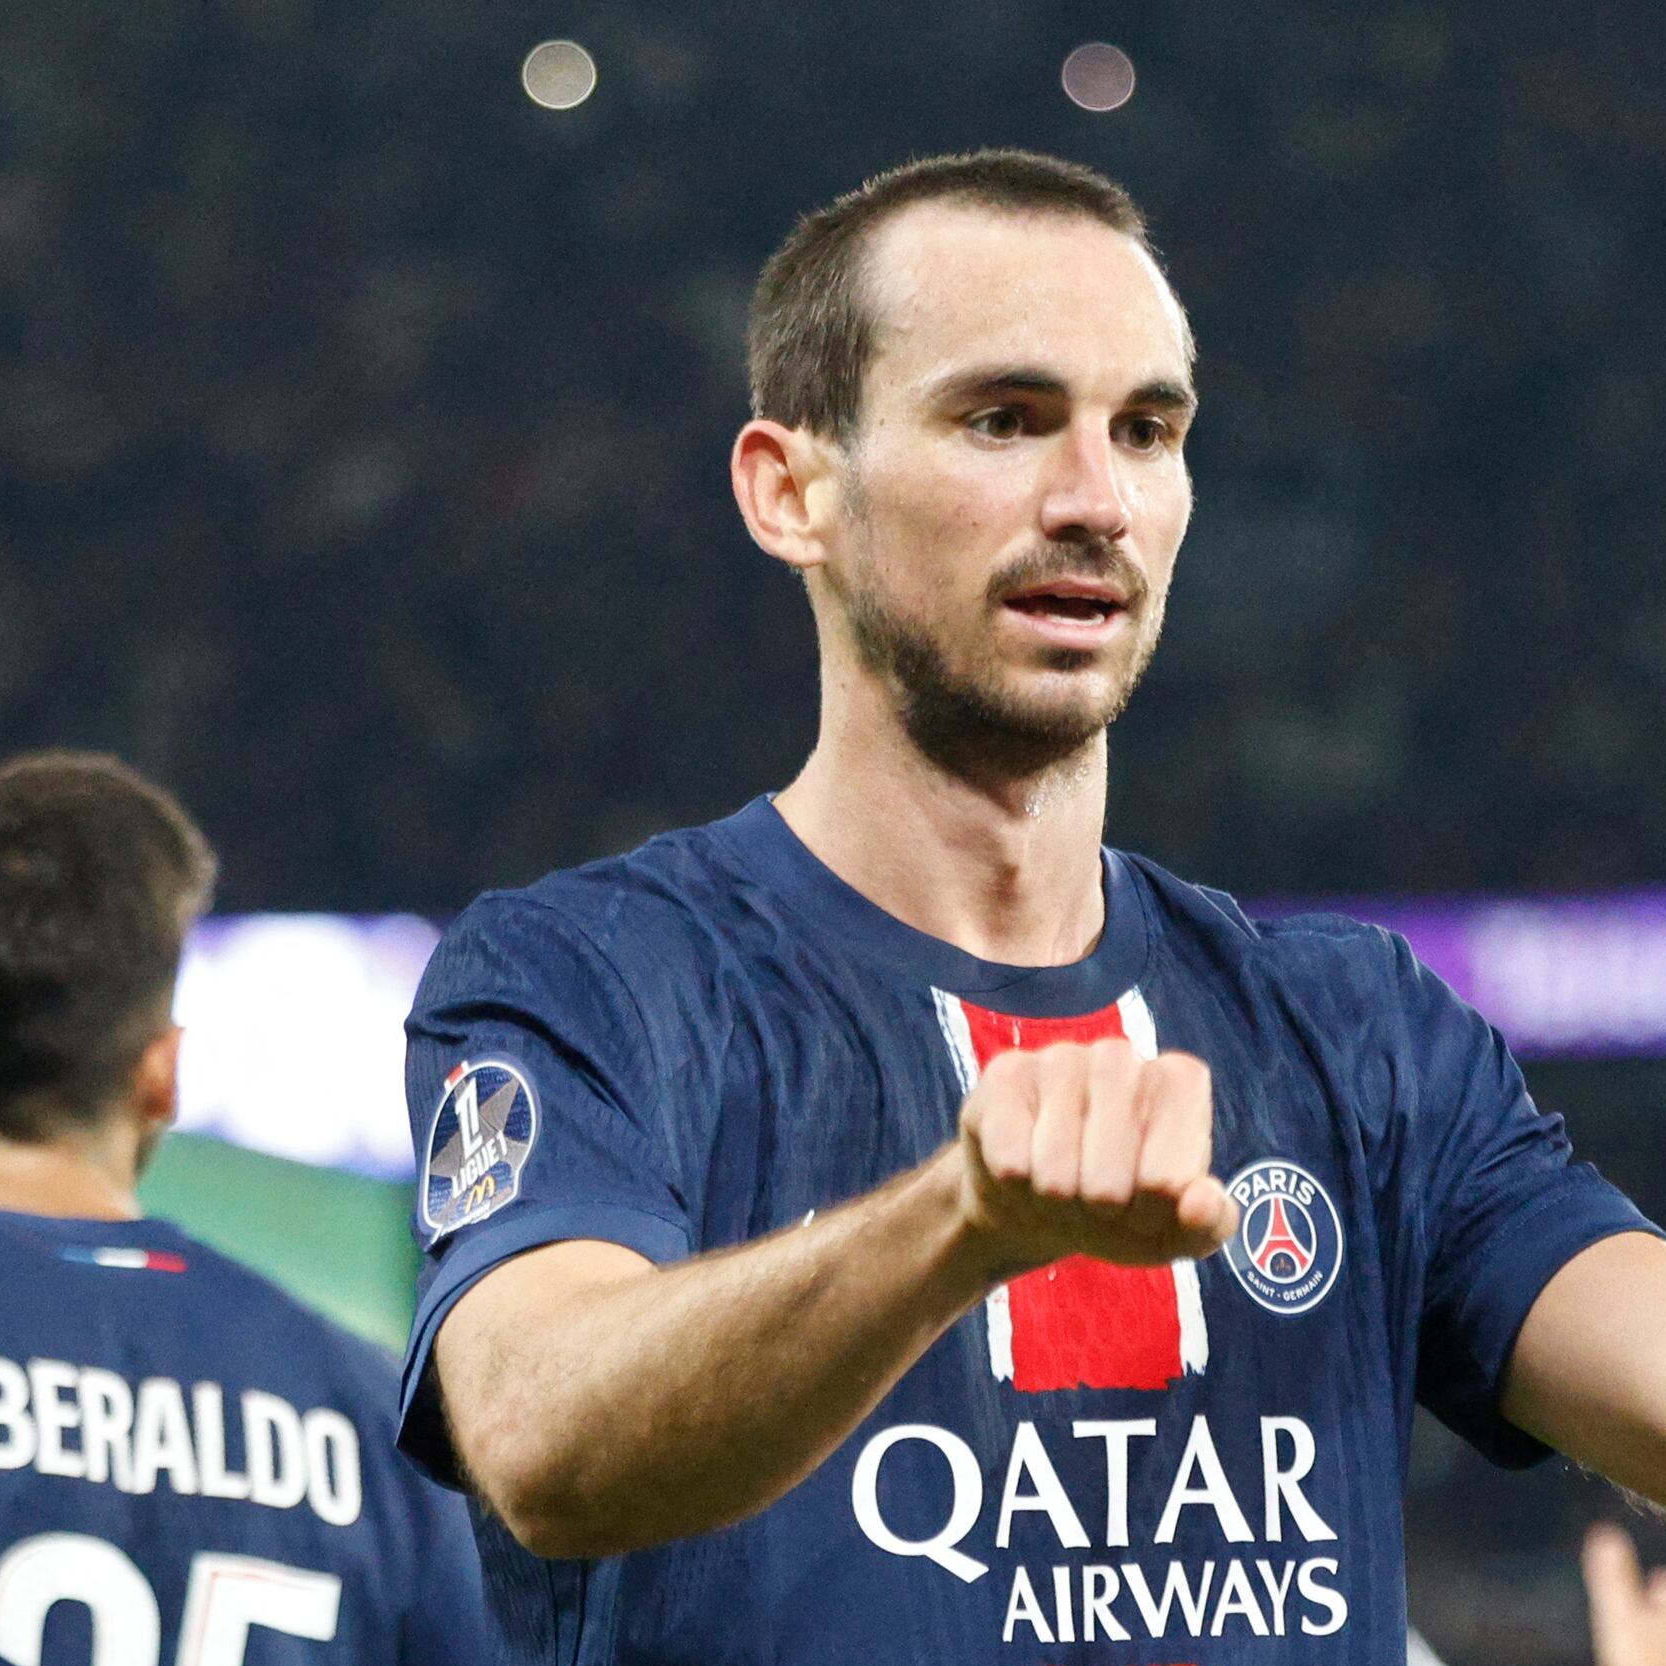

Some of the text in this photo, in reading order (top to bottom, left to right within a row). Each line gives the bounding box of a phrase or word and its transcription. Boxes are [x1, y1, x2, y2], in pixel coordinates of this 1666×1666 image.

[1233, 1168, 1316, 1208] PARIS
[1247, 1270, 1324, 1302] SAINT GERMAIN
[851, 1413, 1339, 1584] QATAR
[1001, 1557, 1350, 1643] AIRWAYS
